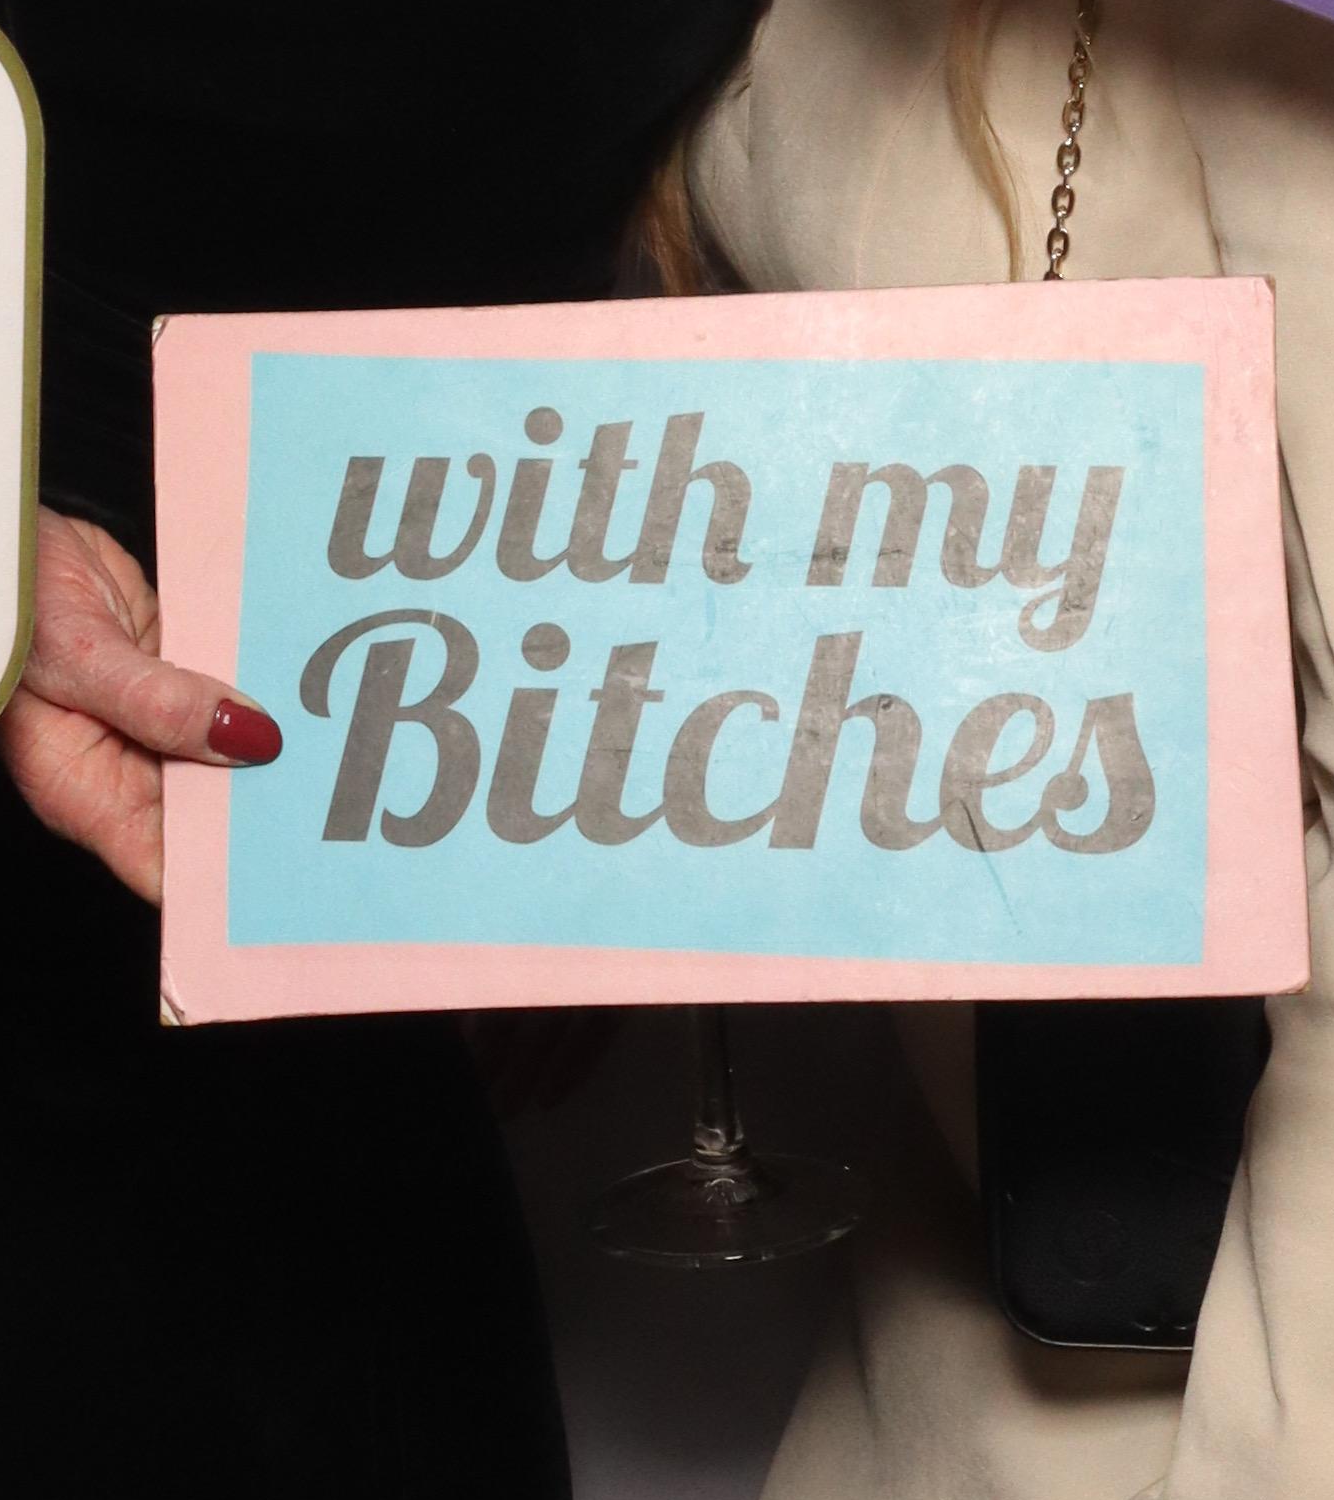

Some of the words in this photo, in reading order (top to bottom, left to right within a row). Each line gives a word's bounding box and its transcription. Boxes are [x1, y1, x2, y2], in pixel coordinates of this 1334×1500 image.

[325, 405, 754, 586] with
[804, 459, 1126, 653] my
[297, 607, 1158, 856] Bitches
